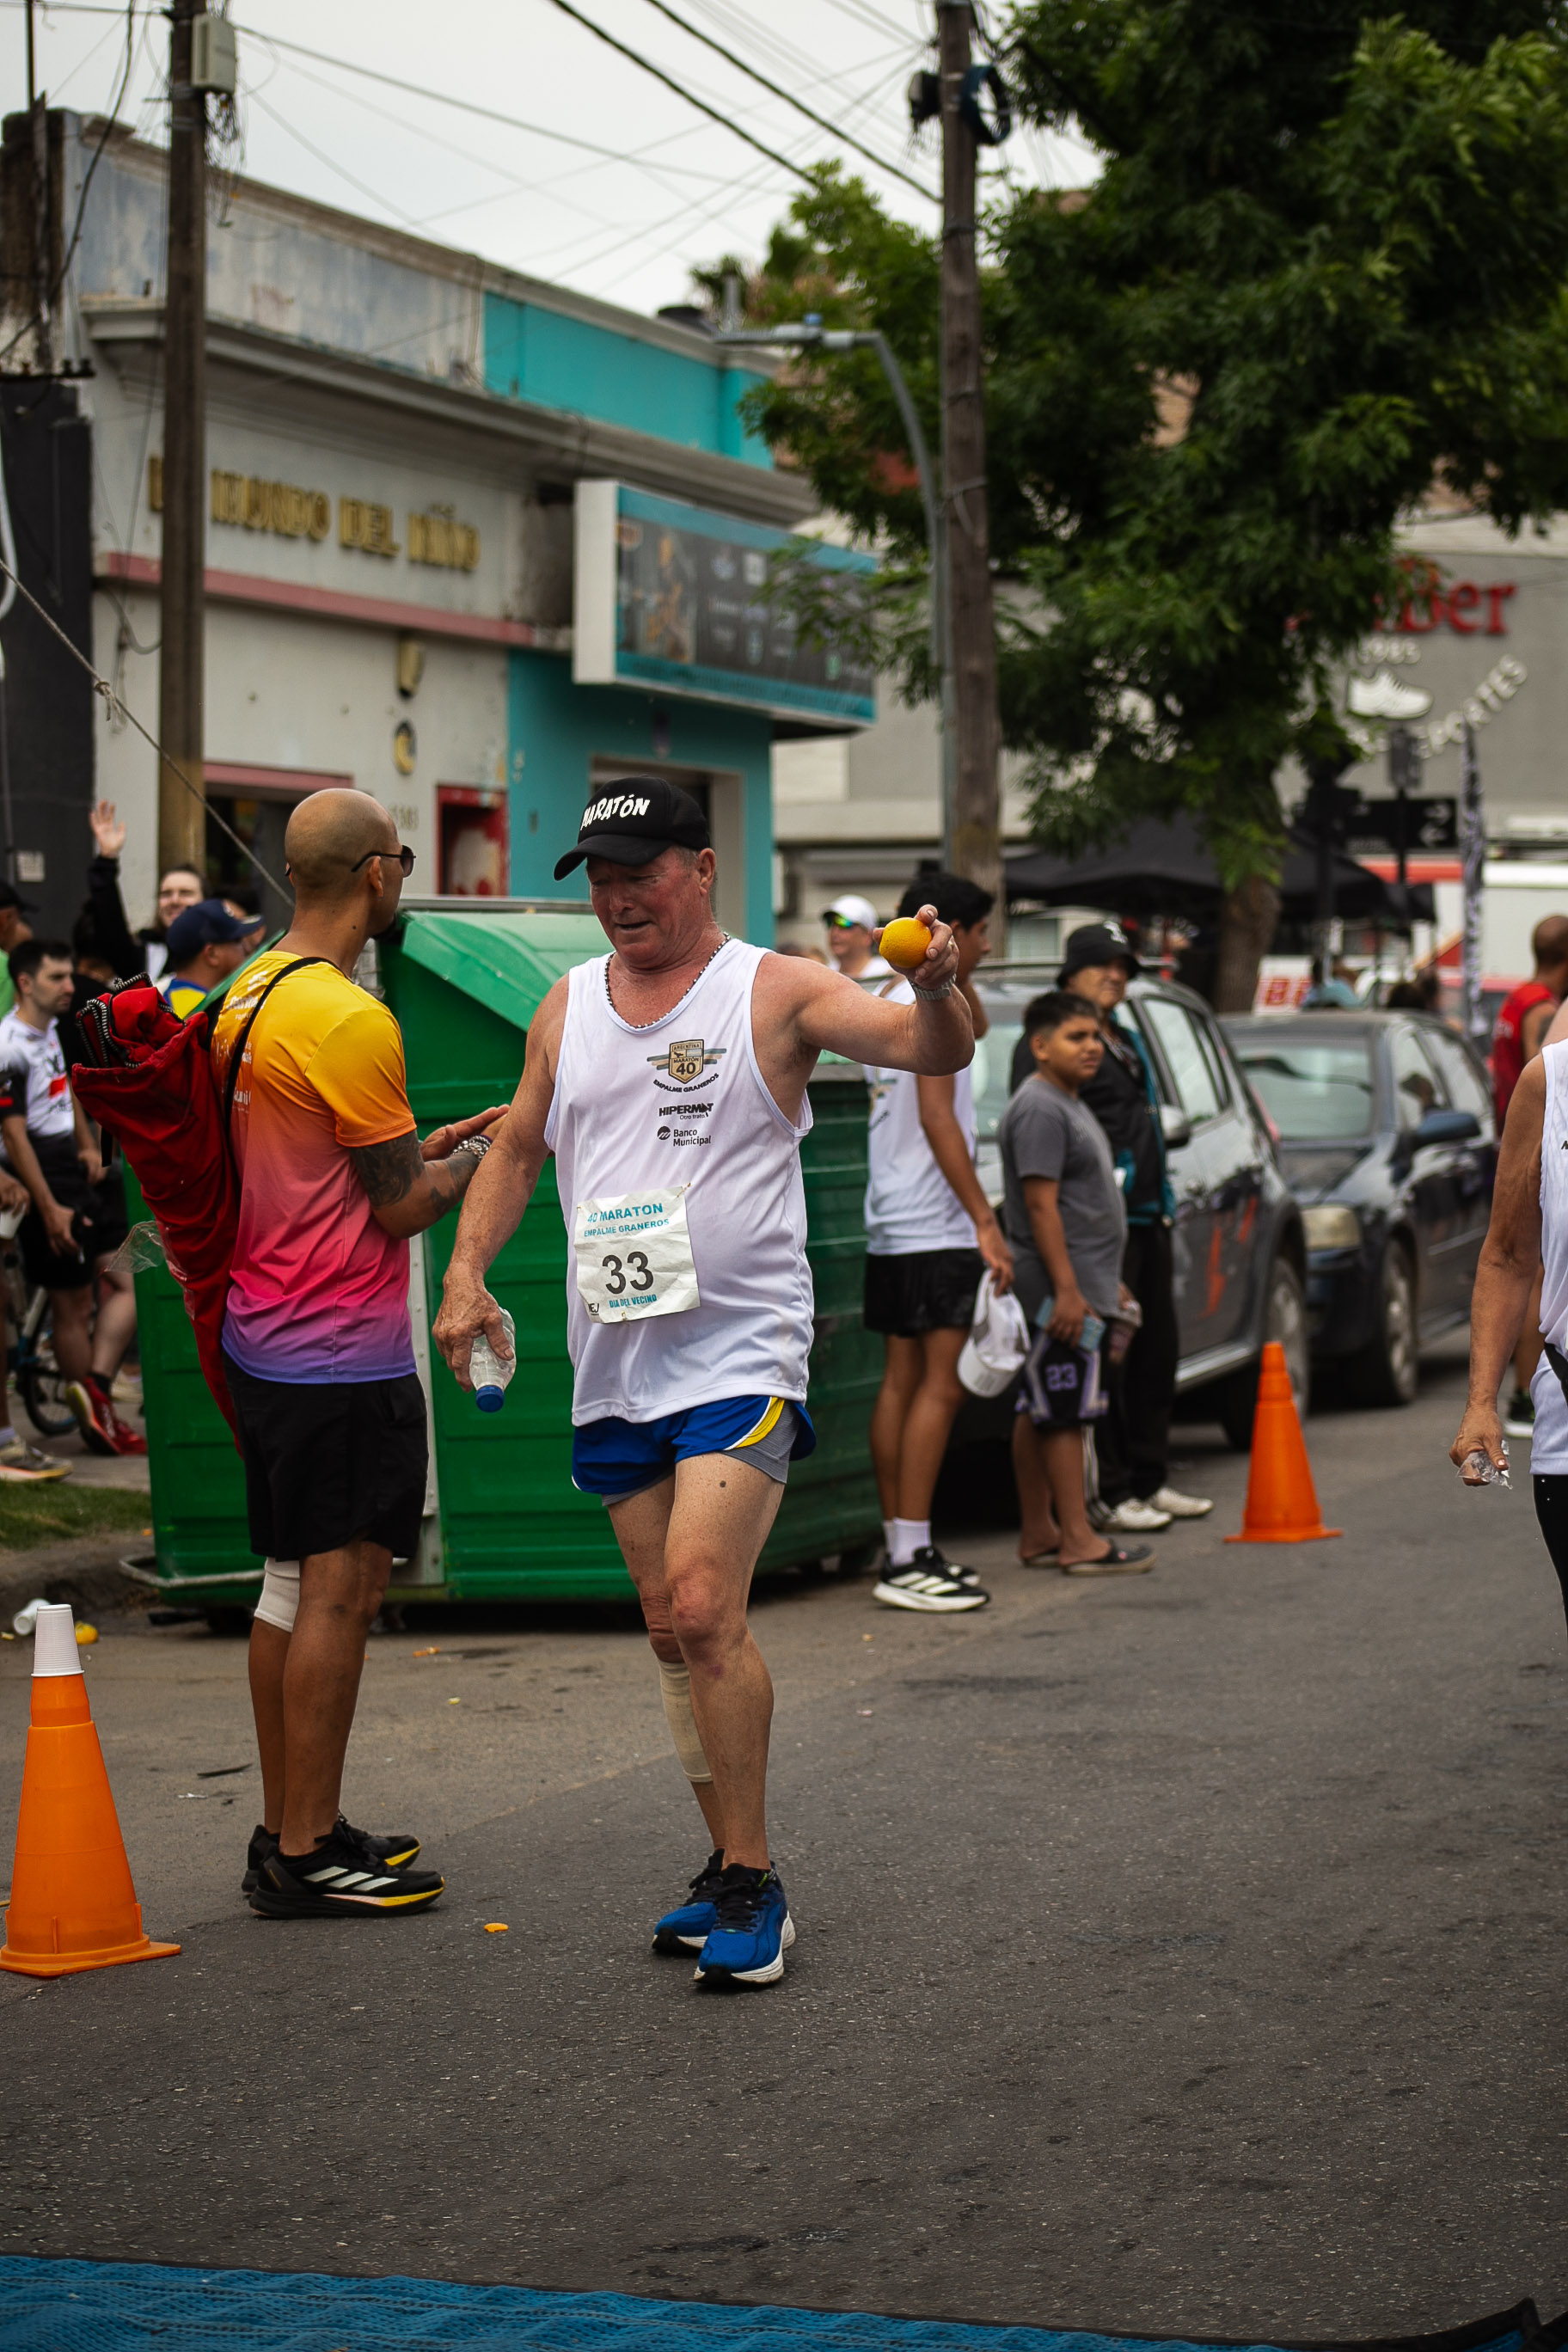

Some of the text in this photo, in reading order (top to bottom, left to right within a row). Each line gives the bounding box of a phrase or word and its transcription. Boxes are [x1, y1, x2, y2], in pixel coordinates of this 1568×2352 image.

[339, 495, 401, 558] DEL
[579, 793, 651, 831] MARATÓN
[676, 1063, 696, 1075] 40
[653, 1073, 720, 1093] EMPALME GRANEROS
[673, 1129, 698, 1137] Banco
[673, 1135, 712, 1147] Municipal
[587, 1203, 664, 1223] 40 MARATON
[584, 1218, 669, 1237] EMPALME GRANEROS
[602, 1251, 654, 1295] 33
[609, 1294, 658, 1308] DIA DEL VECINO
[1045, 1363, 1076, 1391] 23
